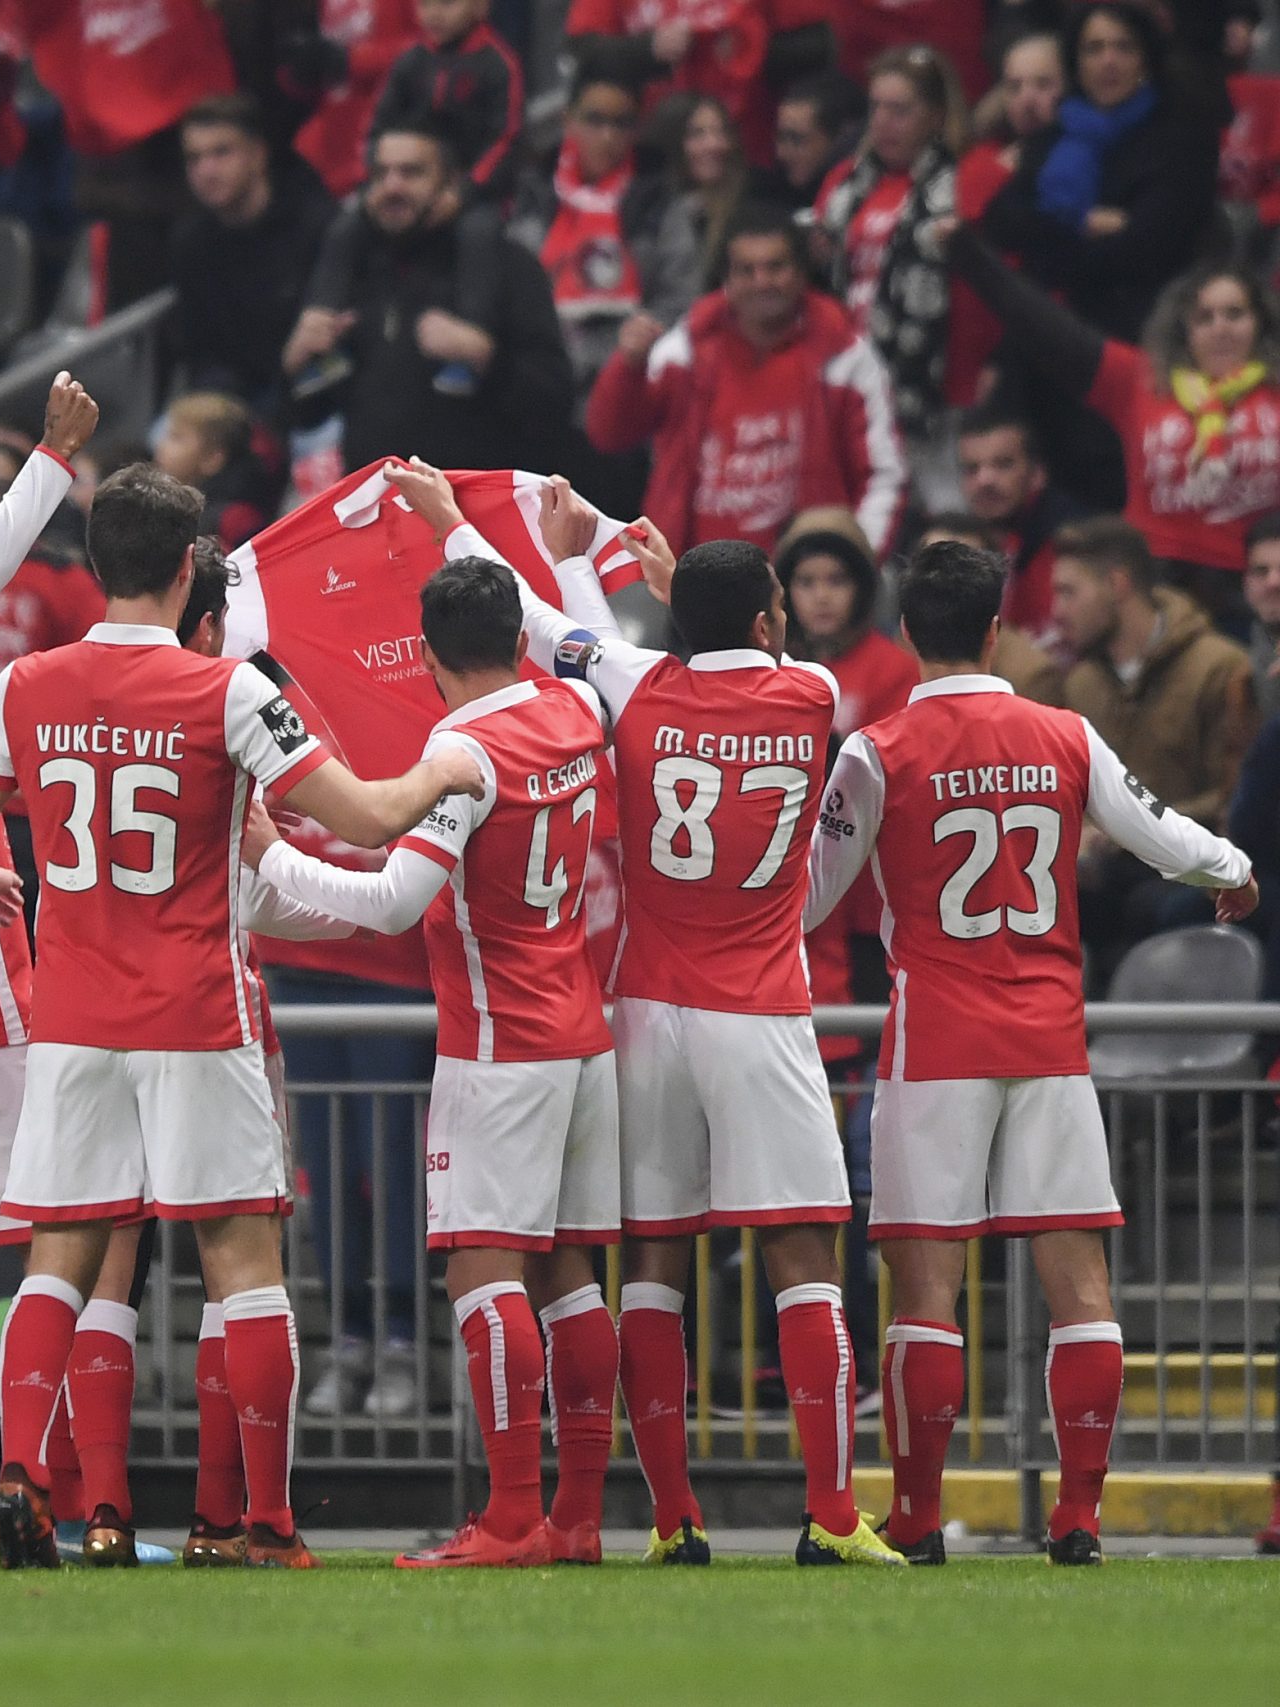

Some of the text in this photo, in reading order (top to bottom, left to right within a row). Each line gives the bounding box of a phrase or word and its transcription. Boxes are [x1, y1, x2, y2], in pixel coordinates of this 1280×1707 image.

[352, 635, 416, 670] VISIT
[36, 716, 186, 761] VUKČEVIĆ
[929, 764, 1058, 801] TEIXEIRA
[38, 756, 181, 897] 35
[426, 809, 459, 832] SEG
[650, 755, 810, 890] 87
[933, 803, 1061, 940] 23
